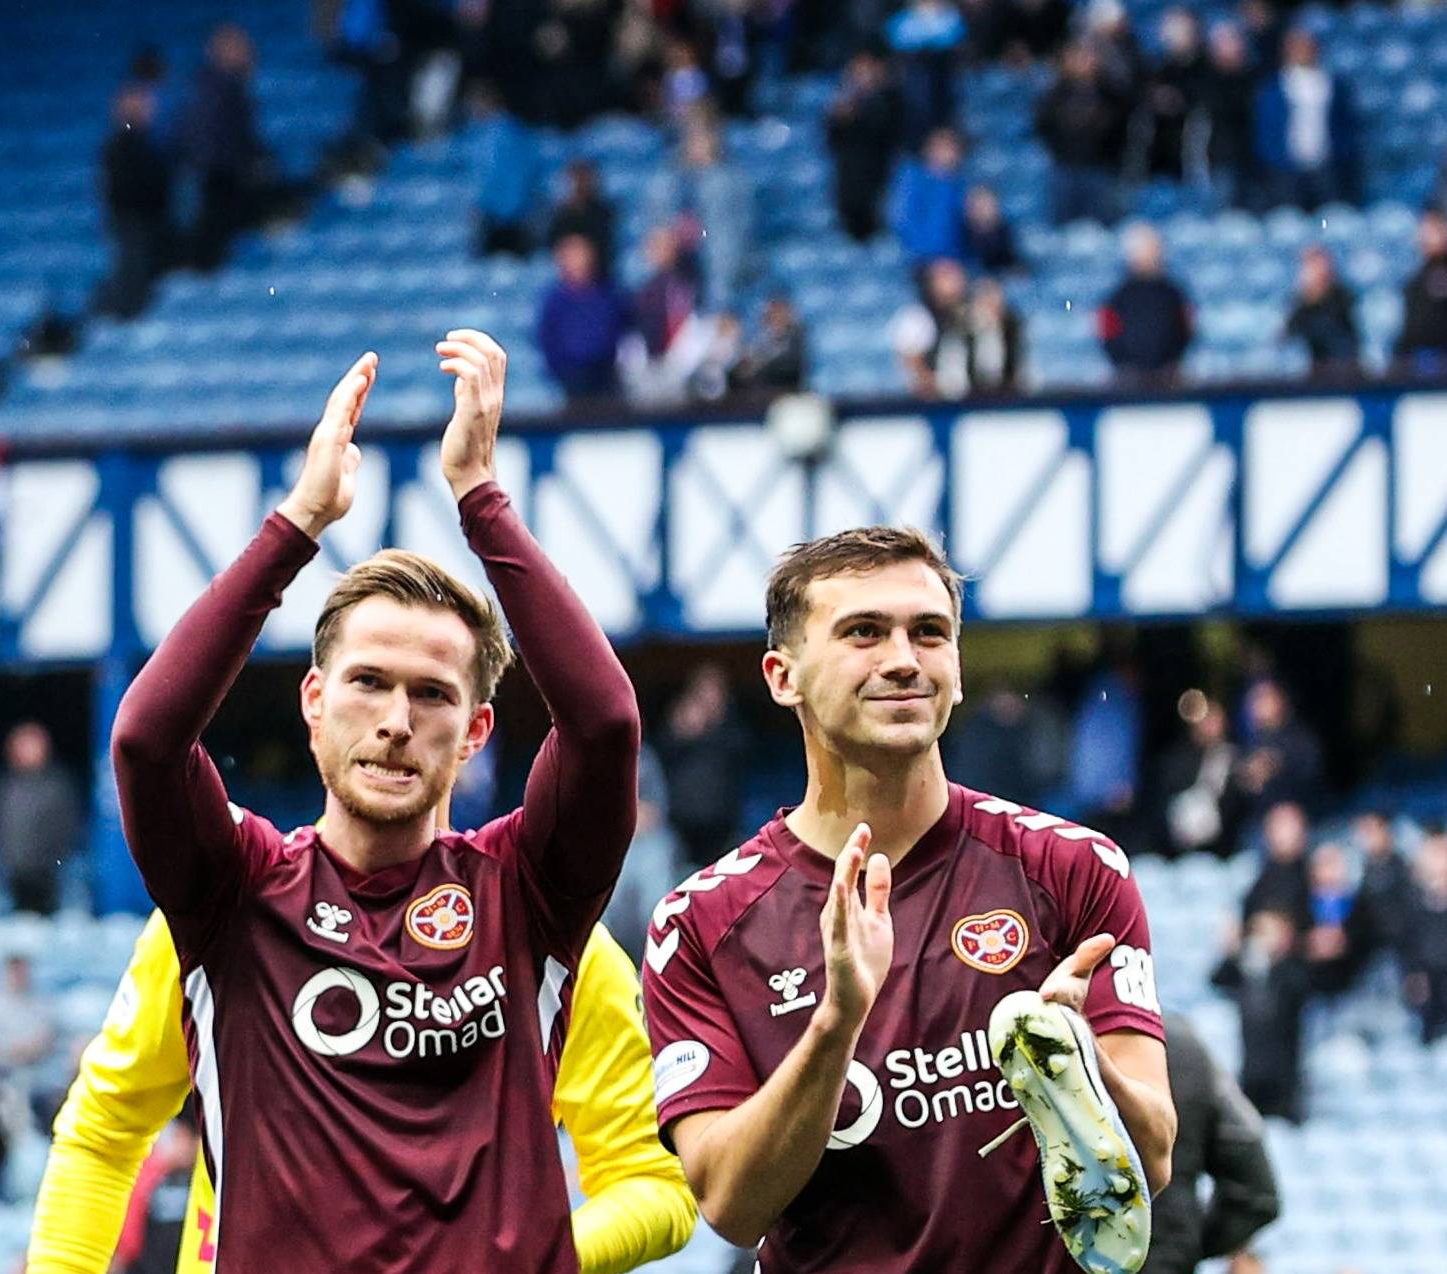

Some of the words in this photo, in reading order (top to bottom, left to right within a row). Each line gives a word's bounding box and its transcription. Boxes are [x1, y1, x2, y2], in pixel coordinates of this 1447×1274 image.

[385, 966, 506, 1024] Stellar
[384, 1000, 506, 1058] Omad
[676, 1049, 696, 1065] HILL
[885, 1030, 1001, 1090] Stell
